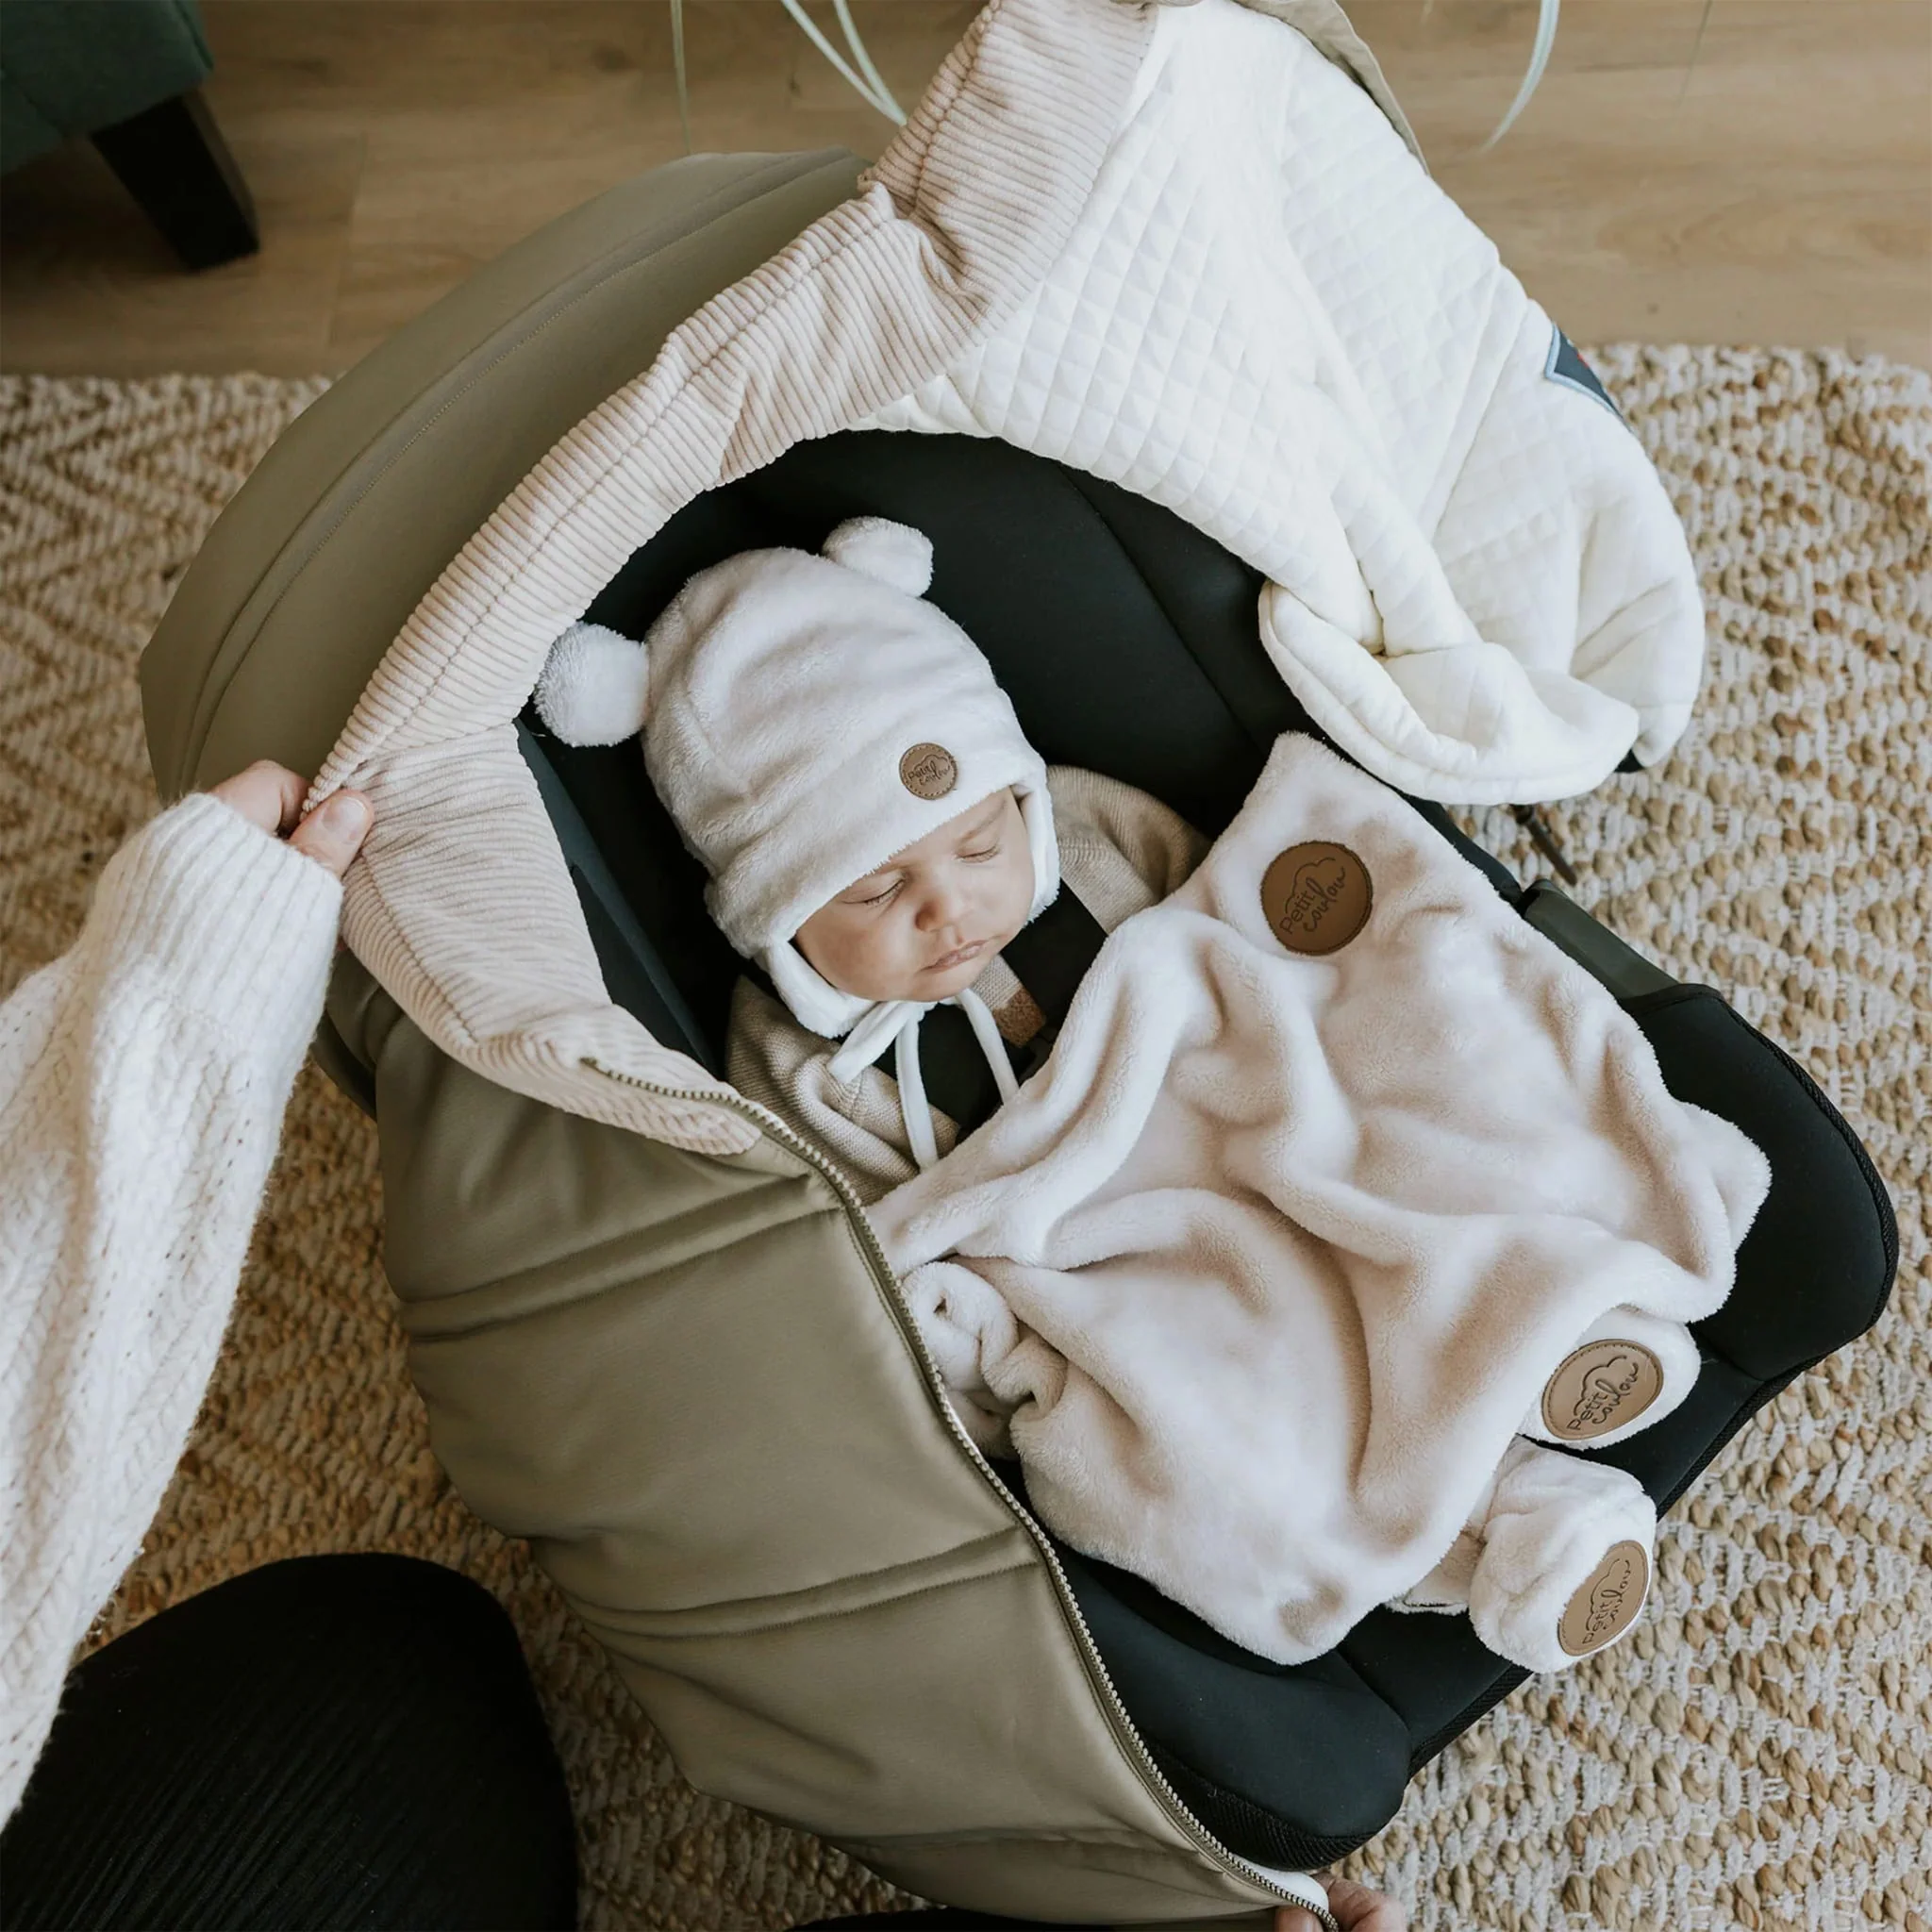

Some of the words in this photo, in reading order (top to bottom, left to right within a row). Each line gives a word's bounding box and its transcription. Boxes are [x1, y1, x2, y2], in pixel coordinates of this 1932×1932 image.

[1279, 891, 1316, 934] Petit
[1567, 1391, 1607, 1430] Petit
[1582, 1601, 1612, 1643] Petit
